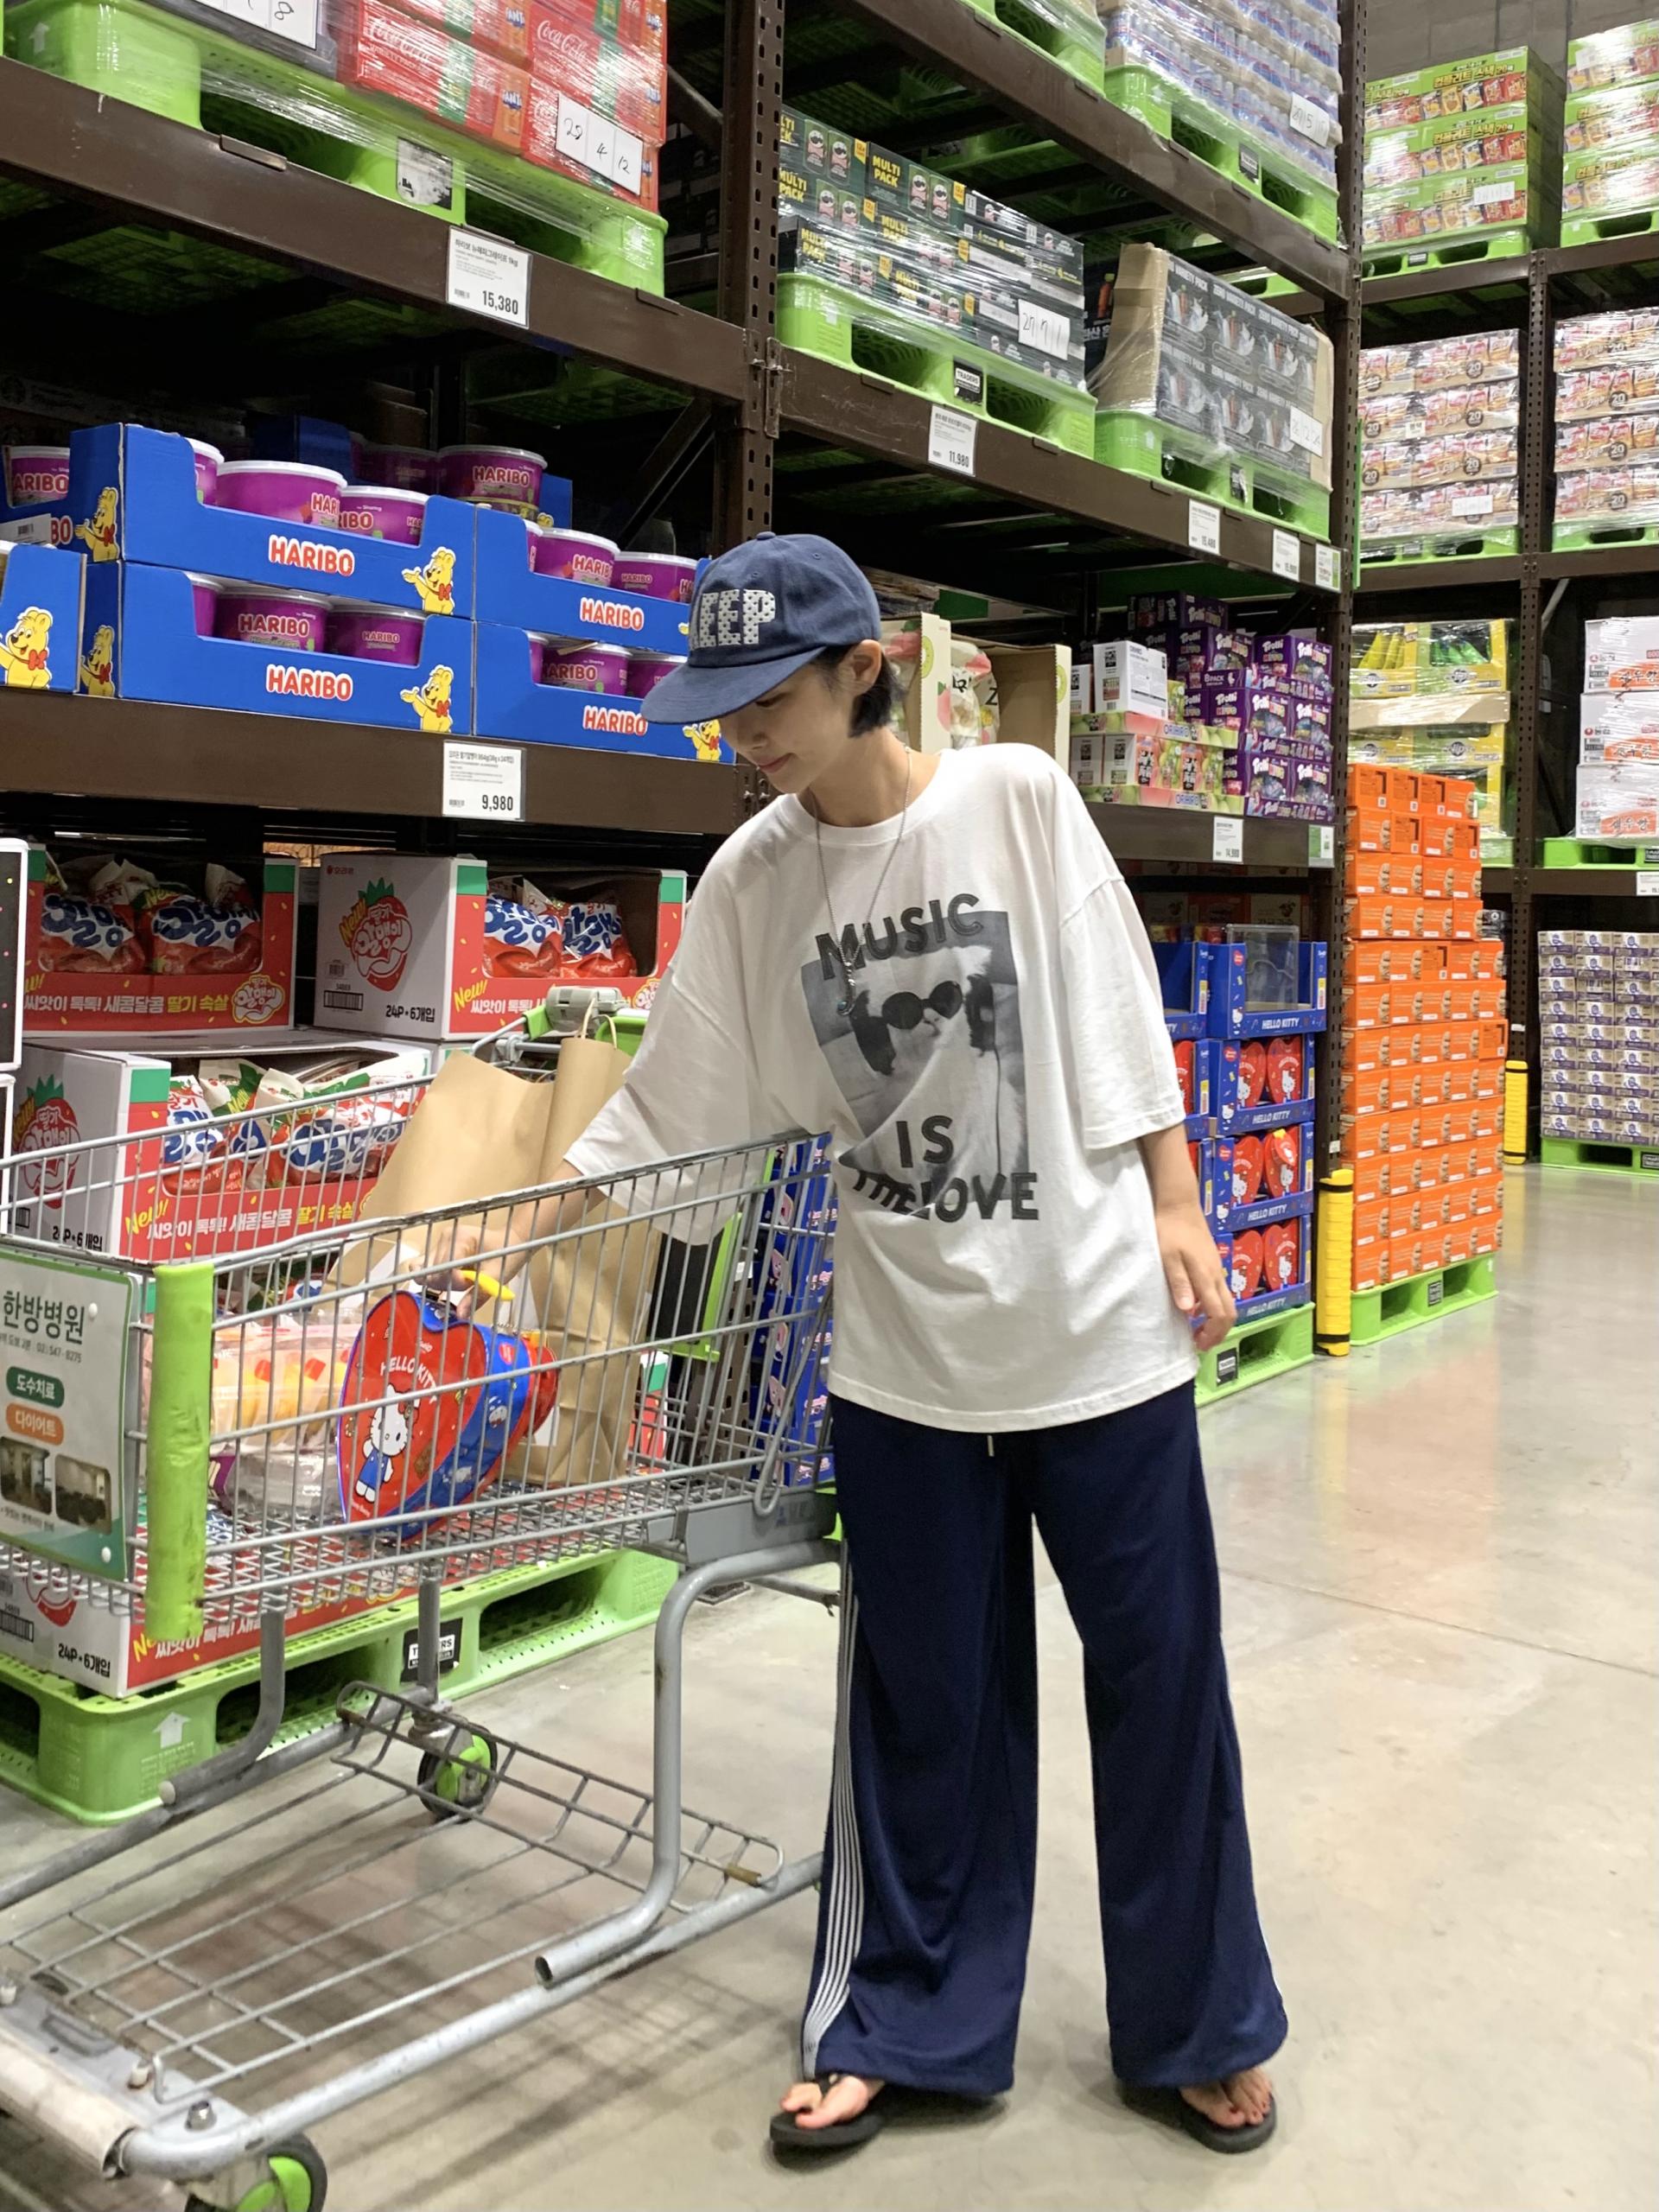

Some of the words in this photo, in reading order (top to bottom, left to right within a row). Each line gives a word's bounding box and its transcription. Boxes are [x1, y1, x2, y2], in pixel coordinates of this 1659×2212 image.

[872, 156, 900, 176] MULTI
[779, 168, 807, 191] MULTI
[874, 168, 899, 188] PACK
[779, 181, 805, 203] PACK
[482, 289, 519, 315] 15,380
[1470, 363, 1481, 372] 20
[1611, 393, 1625, 404] 20
[1470, 411, 1481, 422] 20
[1367, 423, 1378, 431] 20
[1611, 444, 1624, 454] 20
[1465, 459, 1478, 469] 20
[13, 473, 69, 493] ARIBO
[473, 466, 531, 487] HARIBO
[1365, 471, 1376, 480] 20
[311, 493, 340, 516] HARI
[1611, 495, 1624, 505] 20
[406, 517, 423, 528] HAR
[268, 534, 355, 576] HARIBO
[571, 553, 613, 578] HARIB
[620, 573, 653, 585] HARIBO
[580, 597, 645, 632] HARIBO
[698, 588, 776, 649] EEP
[238, 613, 310, 638] HARIBO
[361, 631, 401, 645] HARIBO
[1262, 639, 1284, 652] Trolli
[265, 664, 353, 702] HARIBO
[1215, 691, 1237, 705] Trolli
[582, 704, 648, 736] HARIBO
[482, 794, 513, 811] 9,980
[816, 893, 984, 981] MUSIC
[70, 995, 101, 1012] 톡톡!
[104, 995, 164, 1013] 새콤달콤
[167, 996, 196, 1013] 딸기
[200, 995, 229, 1013] 속살
[454, 980, 488, 1013] New!
[470, 999, 505, 1014] 씨앗이
[1262, 1019, 1281, 1029] HELLO
[1282, 1017, 1300, 1028] KITTY
[38, 1109, 59, 1130] 딸기
[1253, 1113, 1271, 1123] HELLO
[1272, 1110, 1290, 1121] KITTY
[895, 1115, 955, 1168] IS
[909, 1172, 1039, 1224] LOVE
[125, 1198, 169, 1235] New!
[298, 1205, 325, 1225] 딸기
[1248, 1209, 1268, 1221] HELLO
[1268, 1204, 1287, 1216] KITTY
[1247, 1303, 1267, 1316] HELLO
[1267, 1298, 1287, 1310] KITTY
[3, 1290, 85, 1345] 한방병원
[380, 1355, 416, 1376] HELLO
[16, 1373, 56, 1402] 도수치료
[15, 1410, 57, 1438] 다이어트
